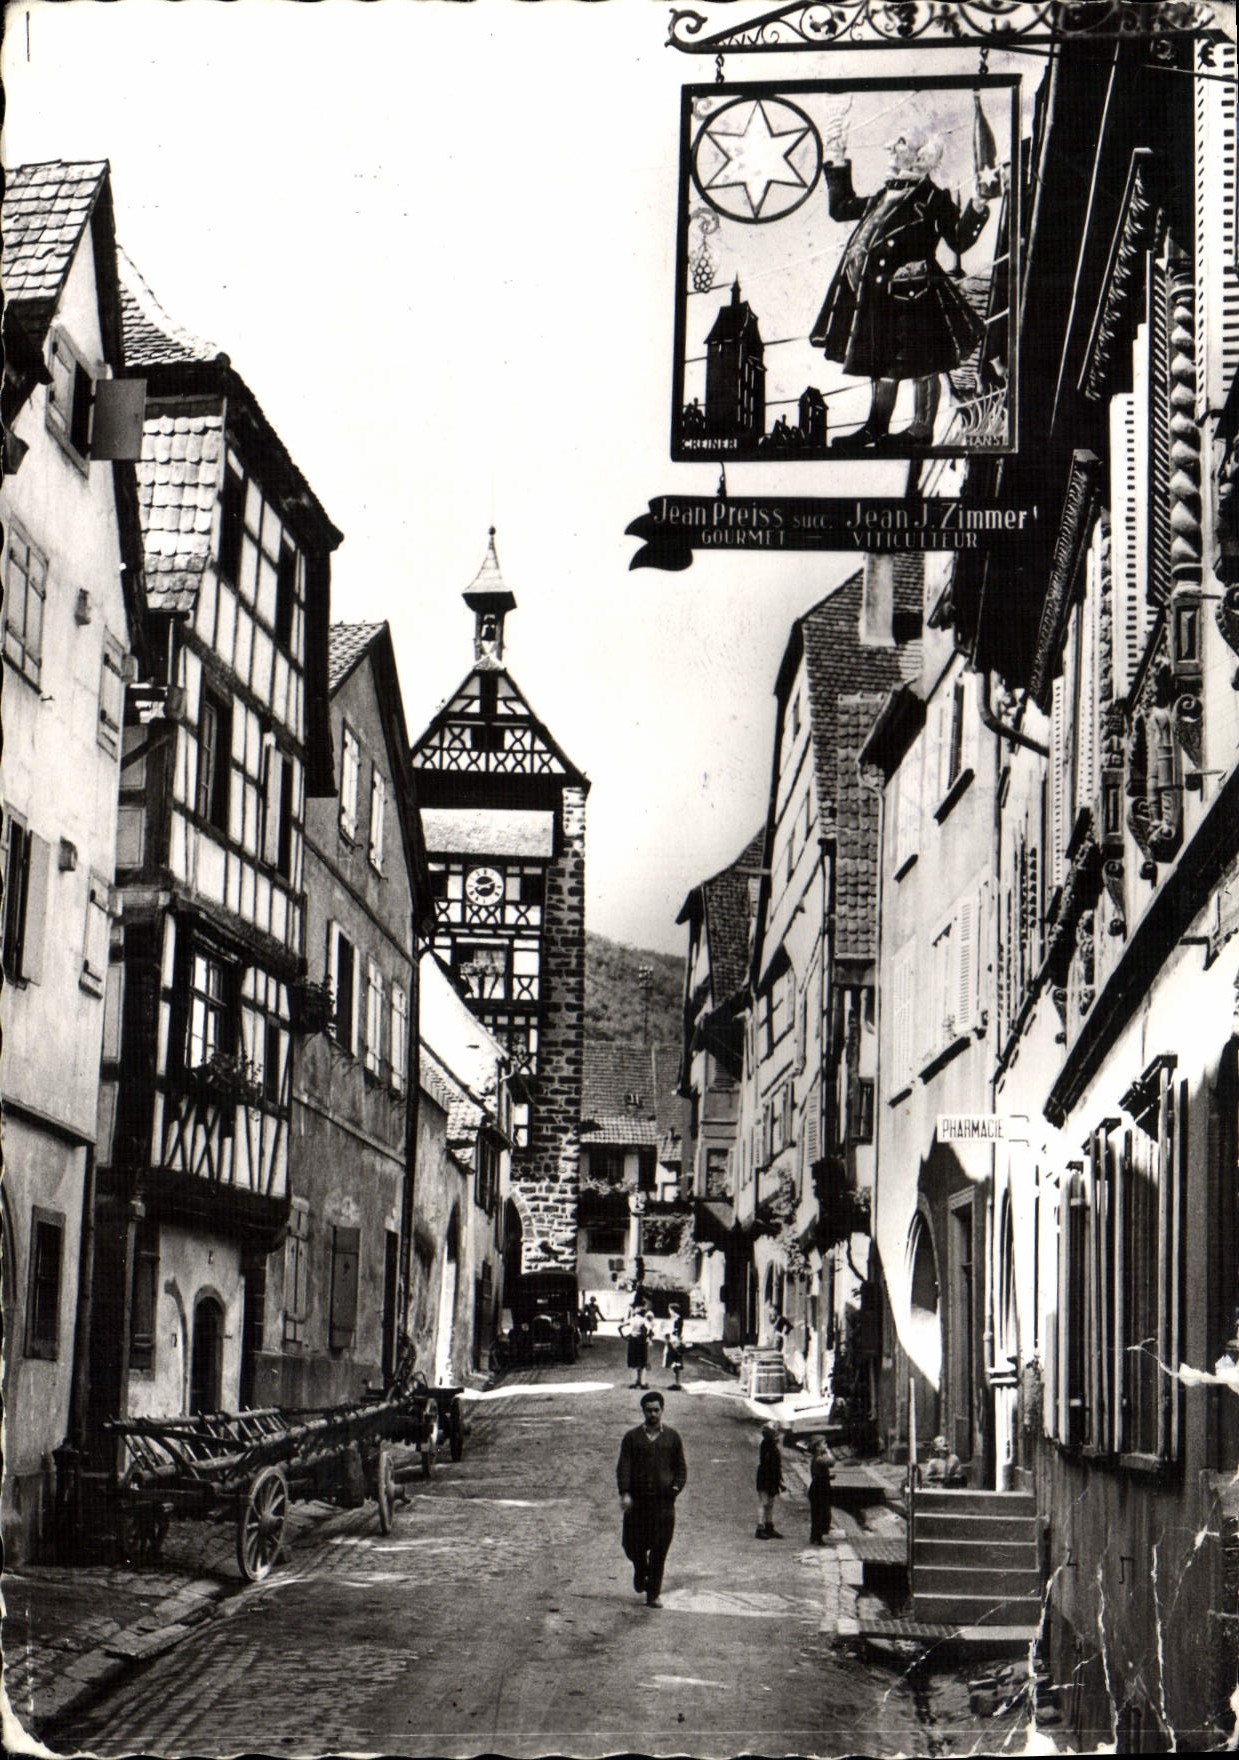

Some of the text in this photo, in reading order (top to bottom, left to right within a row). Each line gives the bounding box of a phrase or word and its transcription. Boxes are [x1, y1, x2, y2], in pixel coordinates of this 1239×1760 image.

[653, 498, 1028, 530] Jean Preiss succ. Jean J. Zimmer
[701, 528, 786, 546] GOURMET
[852, 530, 978, 549] VITICULTEUR
[942, 1118, 1005, 1138] PHARMACIE
